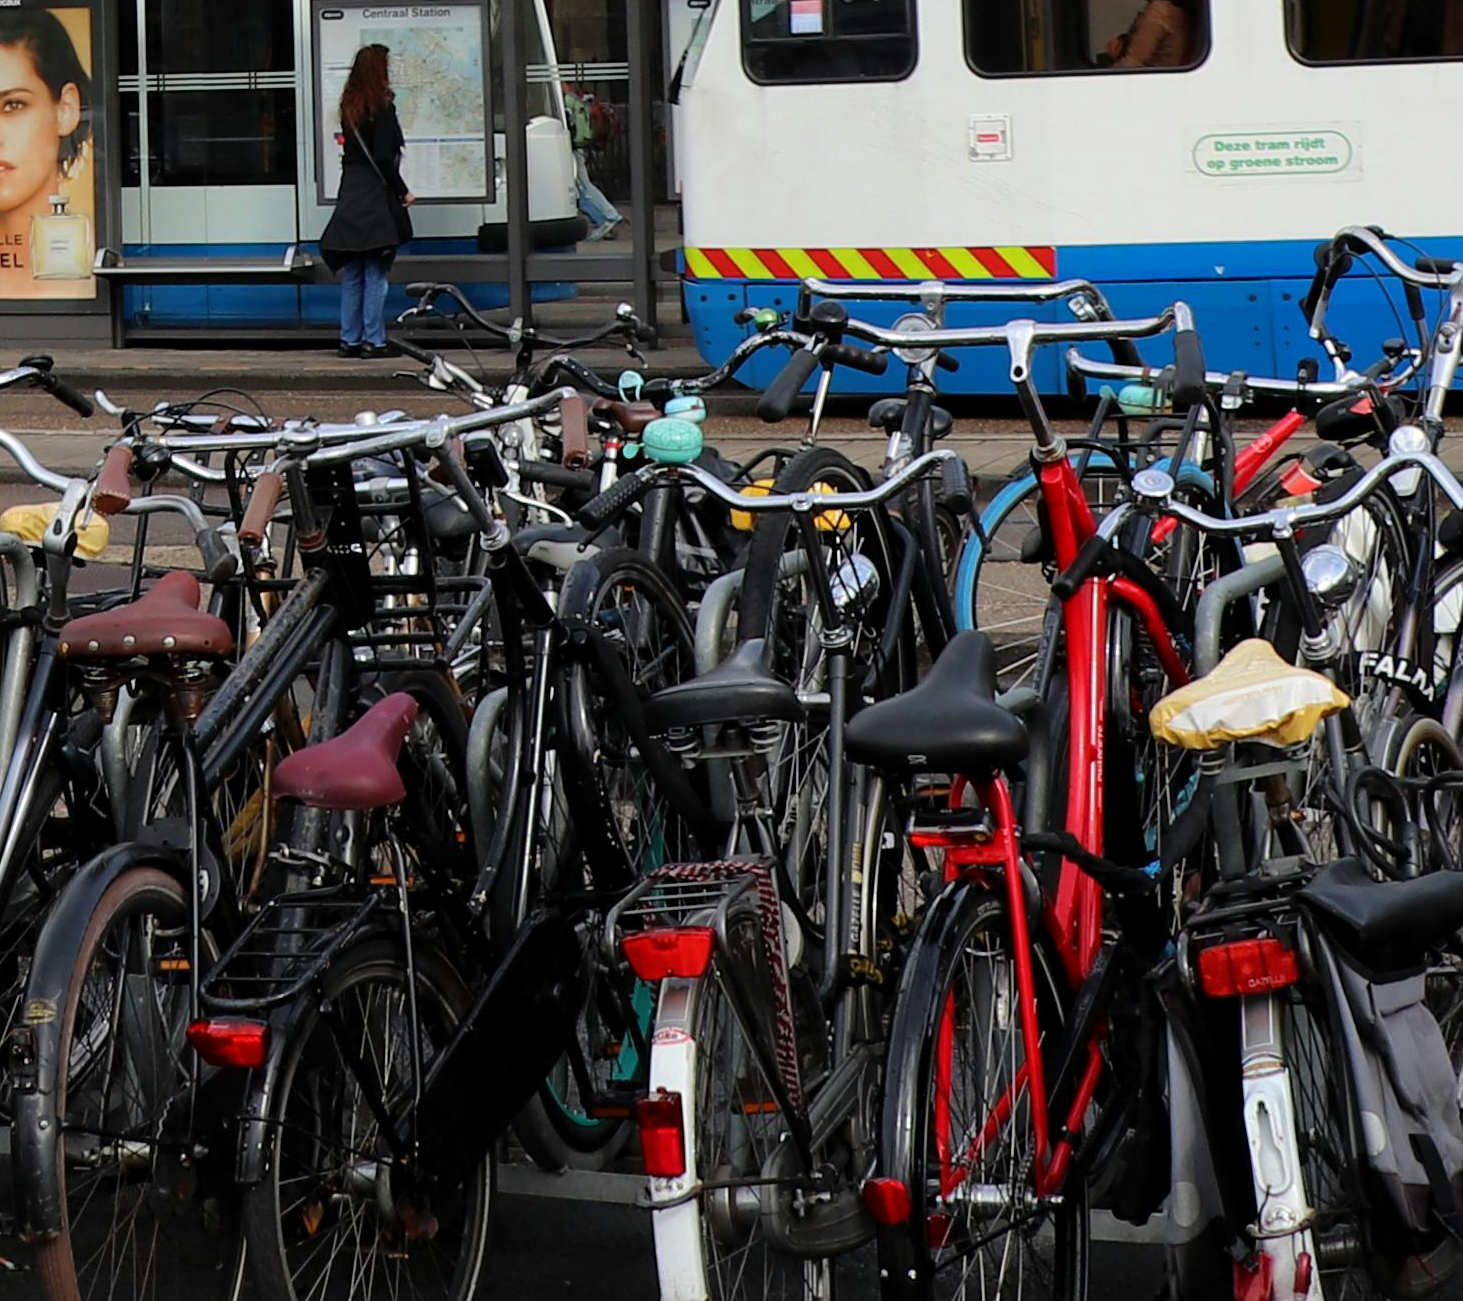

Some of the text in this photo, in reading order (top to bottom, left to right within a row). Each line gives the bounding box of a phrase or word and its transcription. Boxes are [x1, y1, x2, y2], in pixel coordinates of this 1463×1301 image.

[362, 7, 451, 19] Centraal Station
[1214, 137, 1326, 151] Deze tram rijdt
[1207, 154, 1338, 170] op groene stroom
[850, 889, 861, 943] GAZELLE
[1247, 975, 1288, 989] GAZELLE
